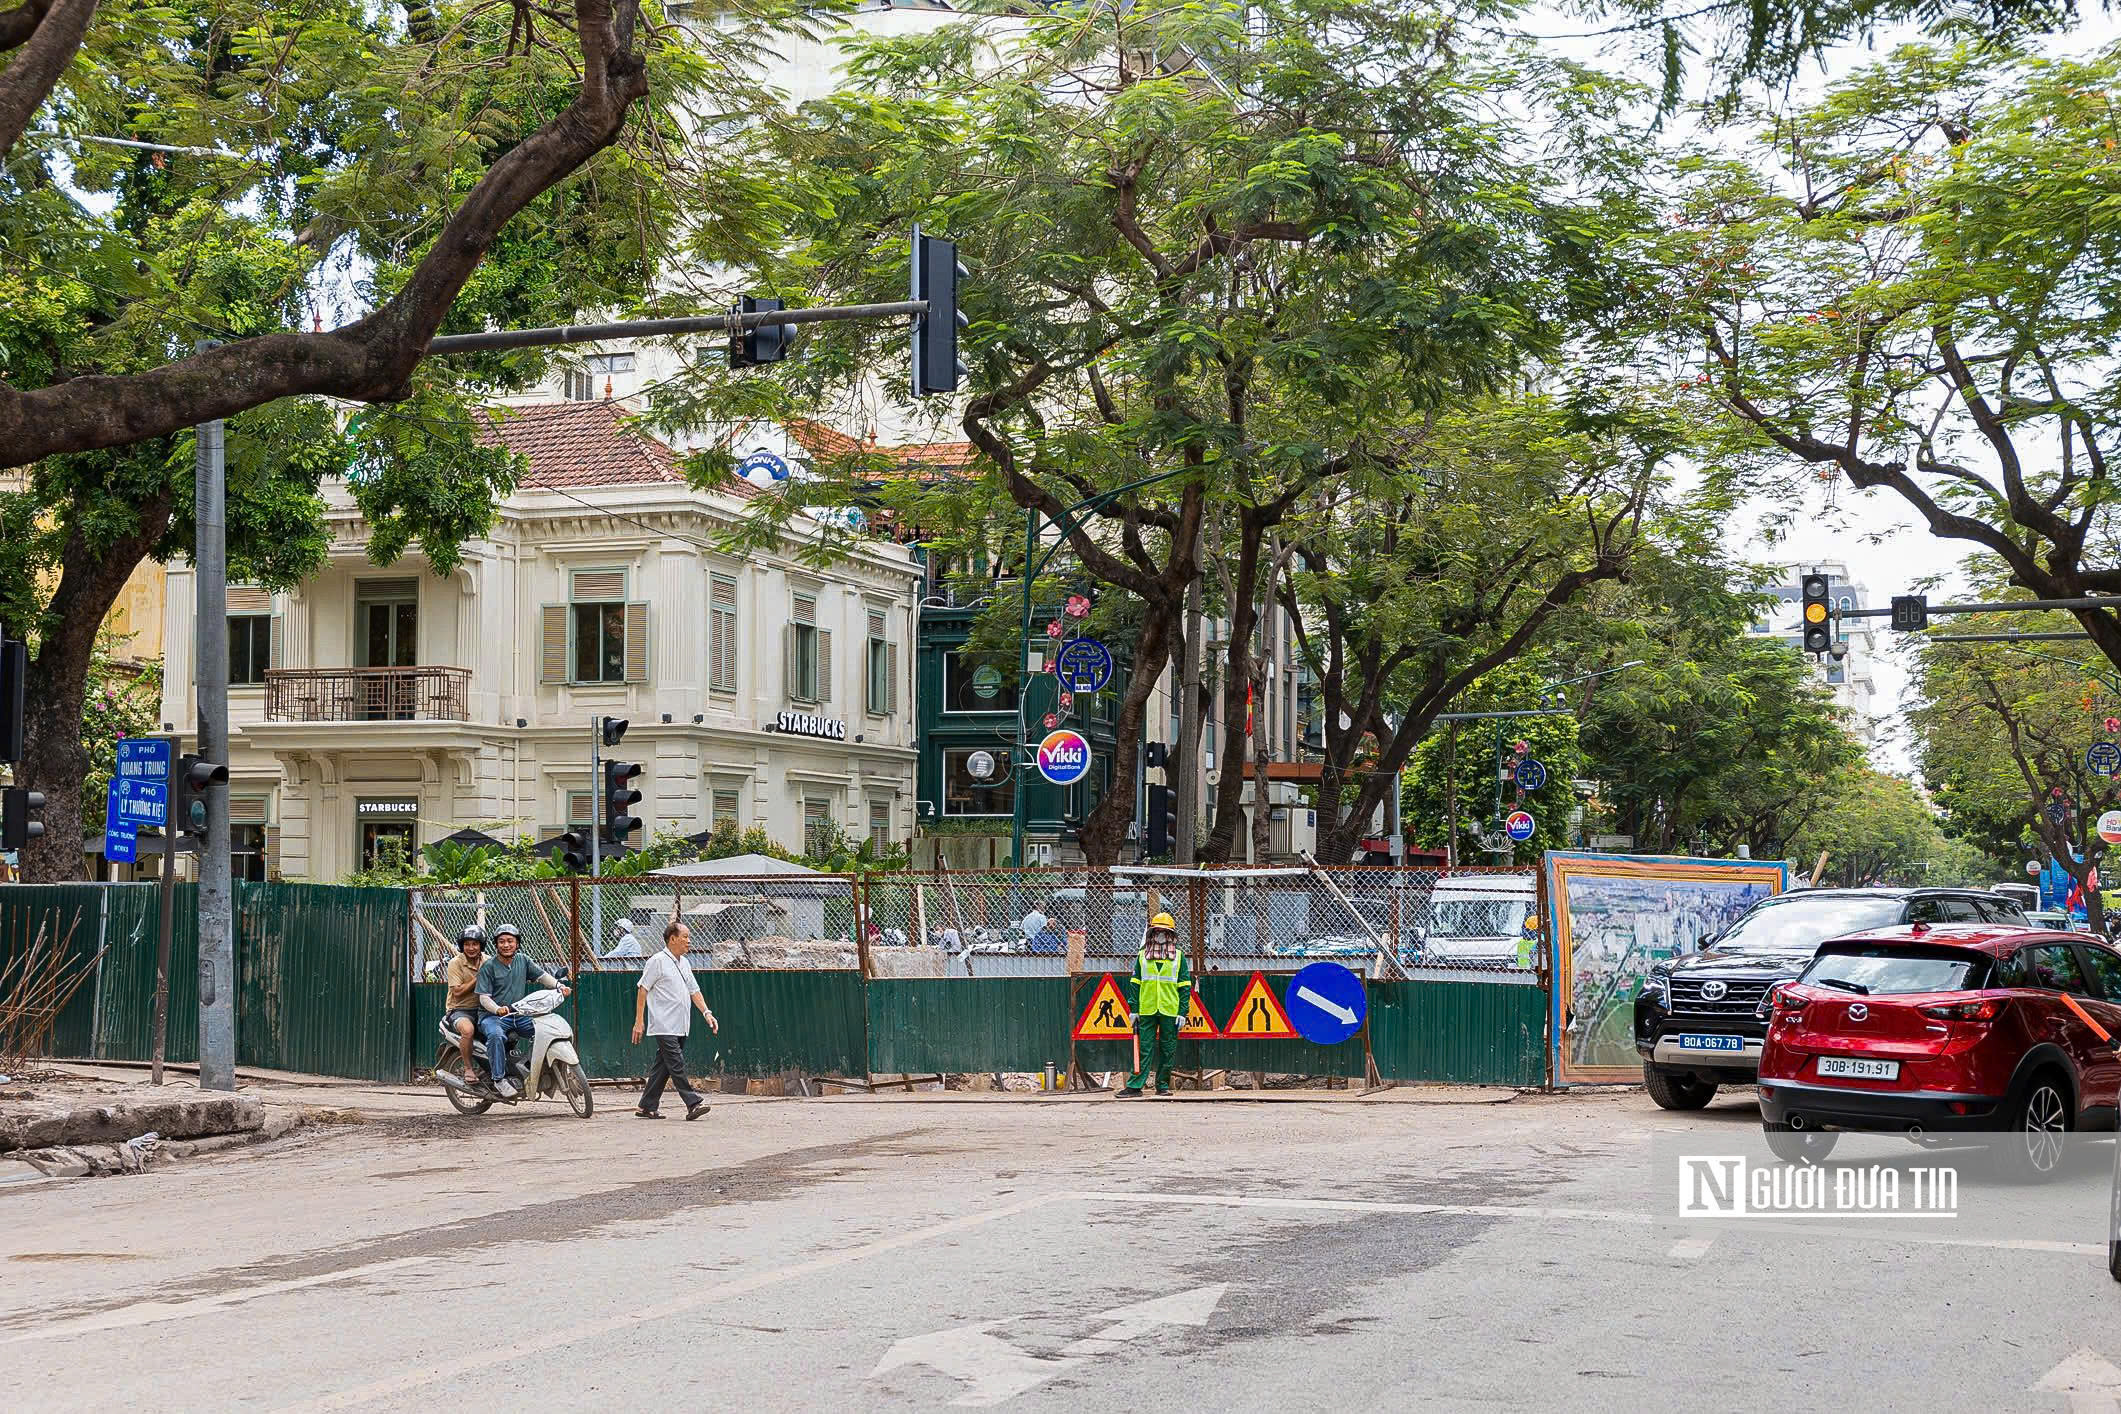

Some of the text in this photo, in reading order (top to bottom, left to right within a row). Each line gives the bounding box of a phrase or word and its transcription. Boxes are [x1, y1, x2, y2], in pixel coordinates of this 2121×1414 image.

[779, 711, 846, 739] STARBUCKS
[138, 744, 156, 754] PHỐ
[1042, 740, 1082, 763] Vikki
[121, 760, 166, 776] QUANG TRUNG
[140, 785, 156, 797] PHỐ
[120, 796, 128, 814] LÝ
[151, 801, 165, 820] KIỆT
[359, 803, 417, 813] STARBUCKS
[1684, 1036, 1738, 1049] 80A-067.78
[1824, 1060, 1890, 1076] 30B-191.91
